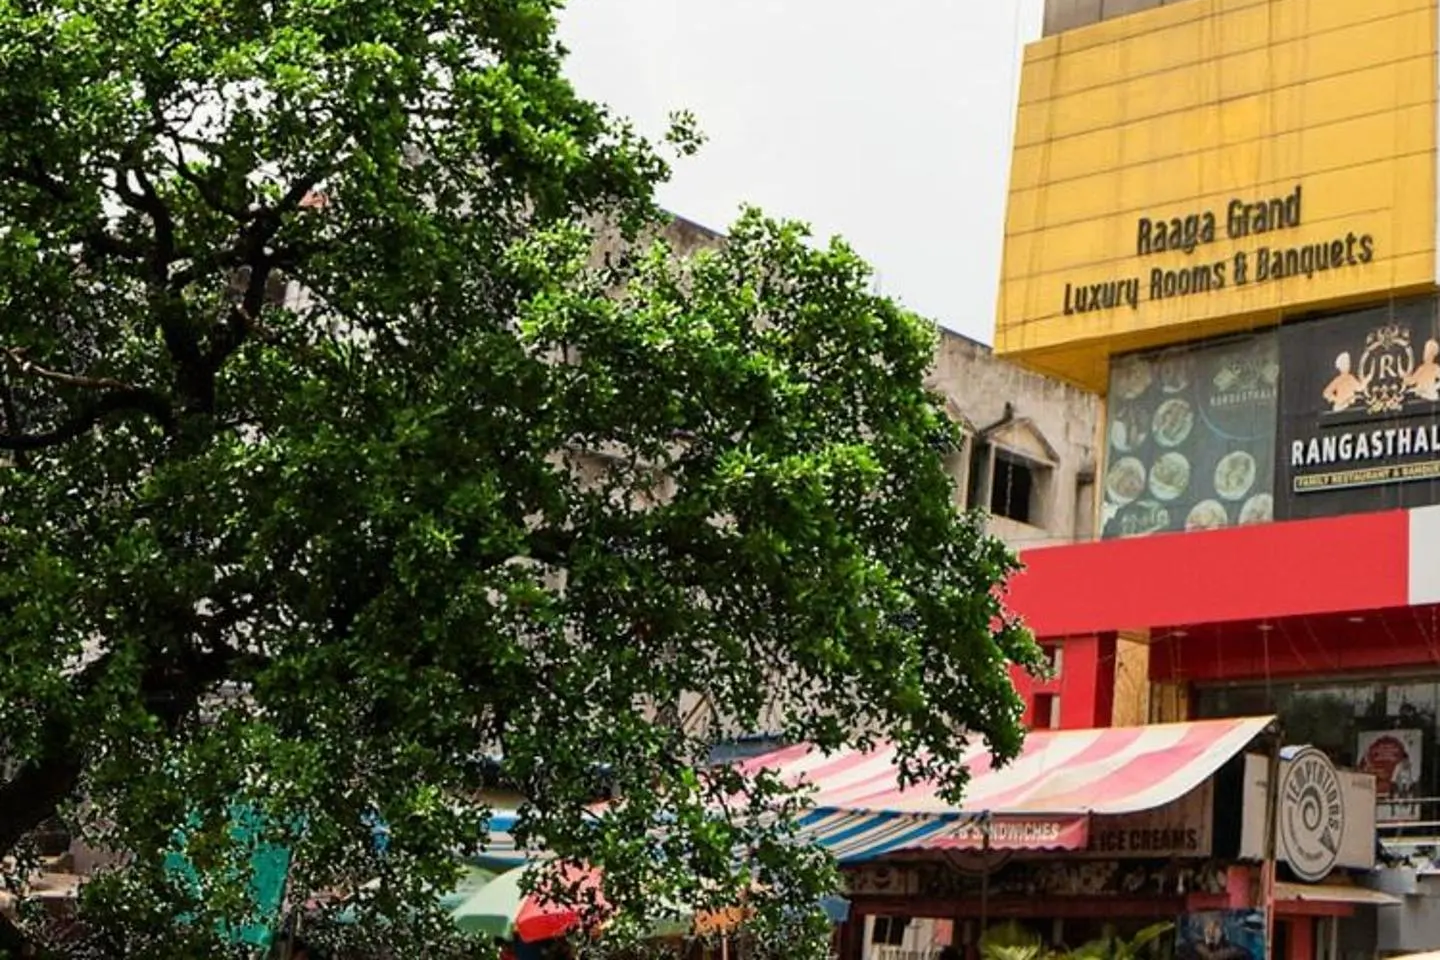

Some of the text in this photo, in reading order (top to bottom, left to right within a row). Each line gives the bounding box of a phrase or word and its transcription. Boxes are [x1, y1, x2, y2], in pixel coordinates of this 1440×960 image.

[1137, 186, 1302, 255] Raaga Grand
[1063, 232, 1374, 316] Luxury Rooms & Banquets
[1129, 828, 1198, 851] CREAMS
